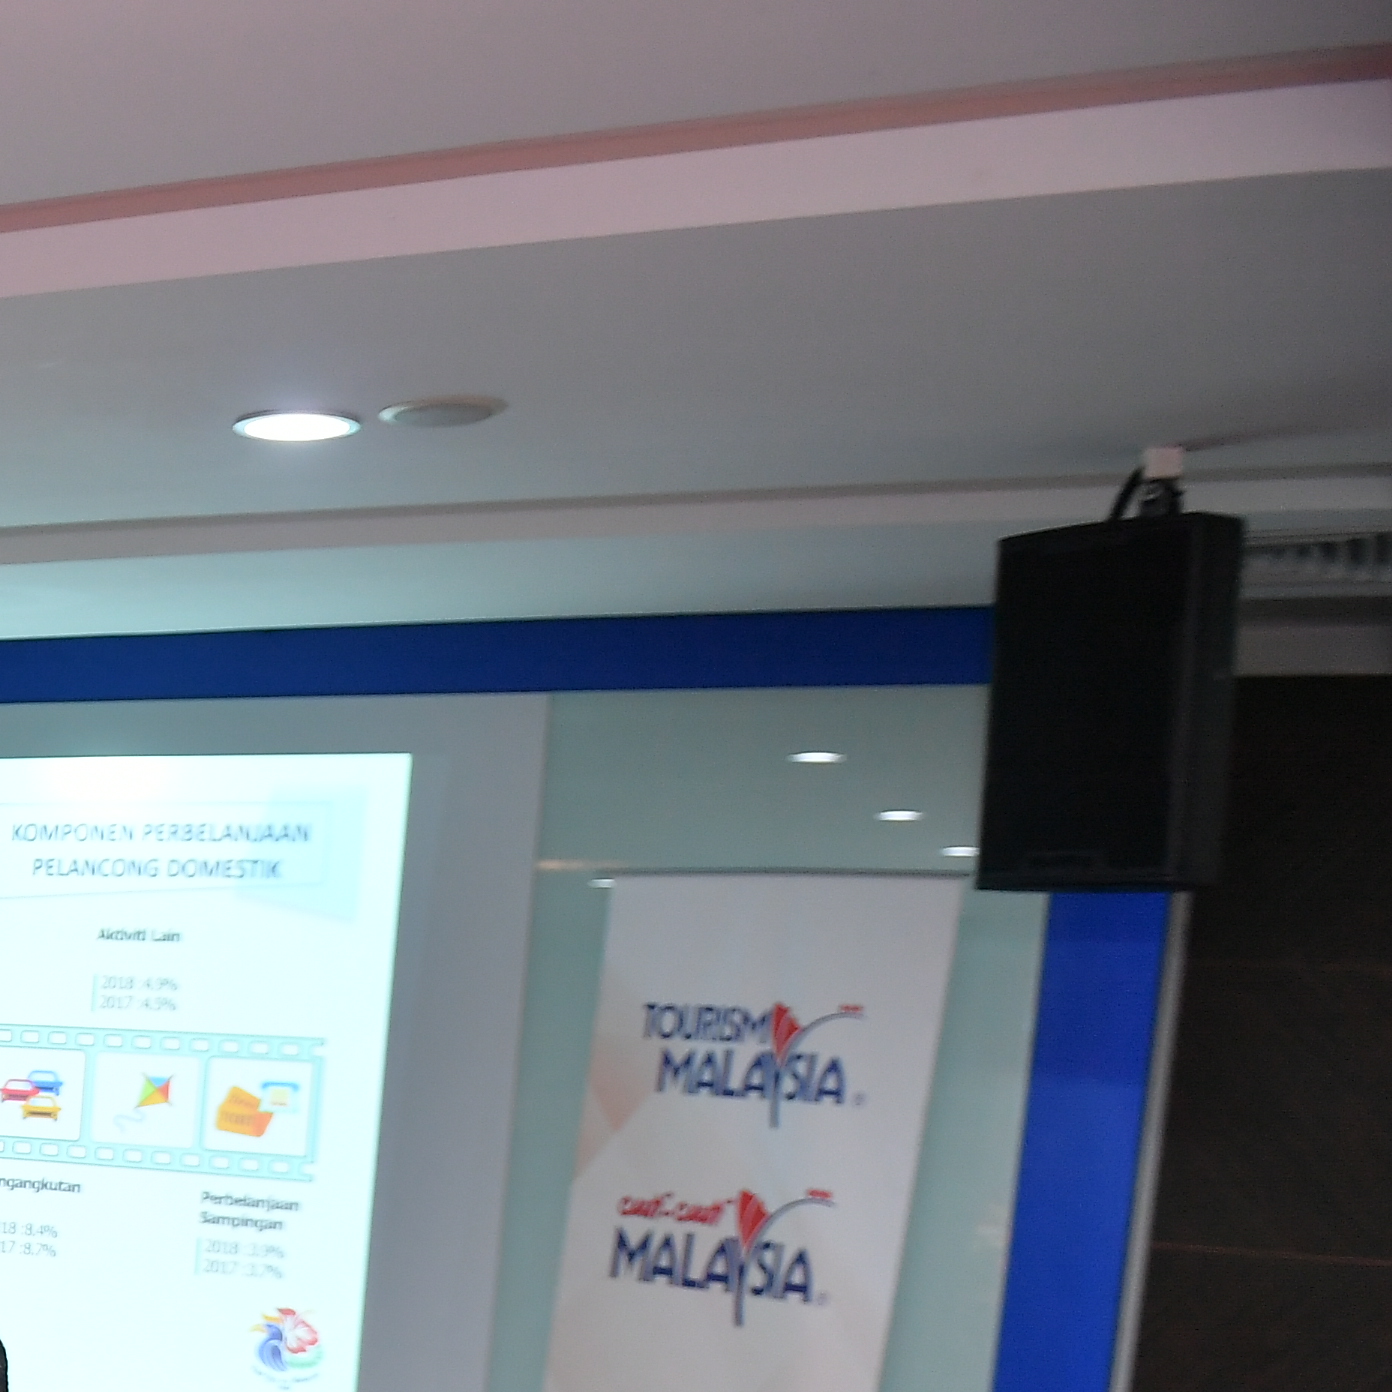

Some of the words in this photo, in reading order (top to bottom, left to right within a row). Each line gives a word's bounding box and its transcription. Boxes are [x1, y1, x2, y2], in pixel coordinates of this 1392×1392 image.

[12, 823, 134, 842] KOMPONEN
[142, 823, 312, 842] PERBELANJAAN
[33, 858, 159, 877] PELANCONG
[167, 858, 282, 878] DOMESTIK
[151, 929, 181, 942] Lain
[643, 1002, 773, 1043] TOURISM
[654, 1048, 846, 1128] MALAYSIA
[202, 1192, 300, 1212] Perbelanjaan
[199, 1212, 284, 1231] Sampingan
[609, 1225, 813, 1326] MALAYSIA
